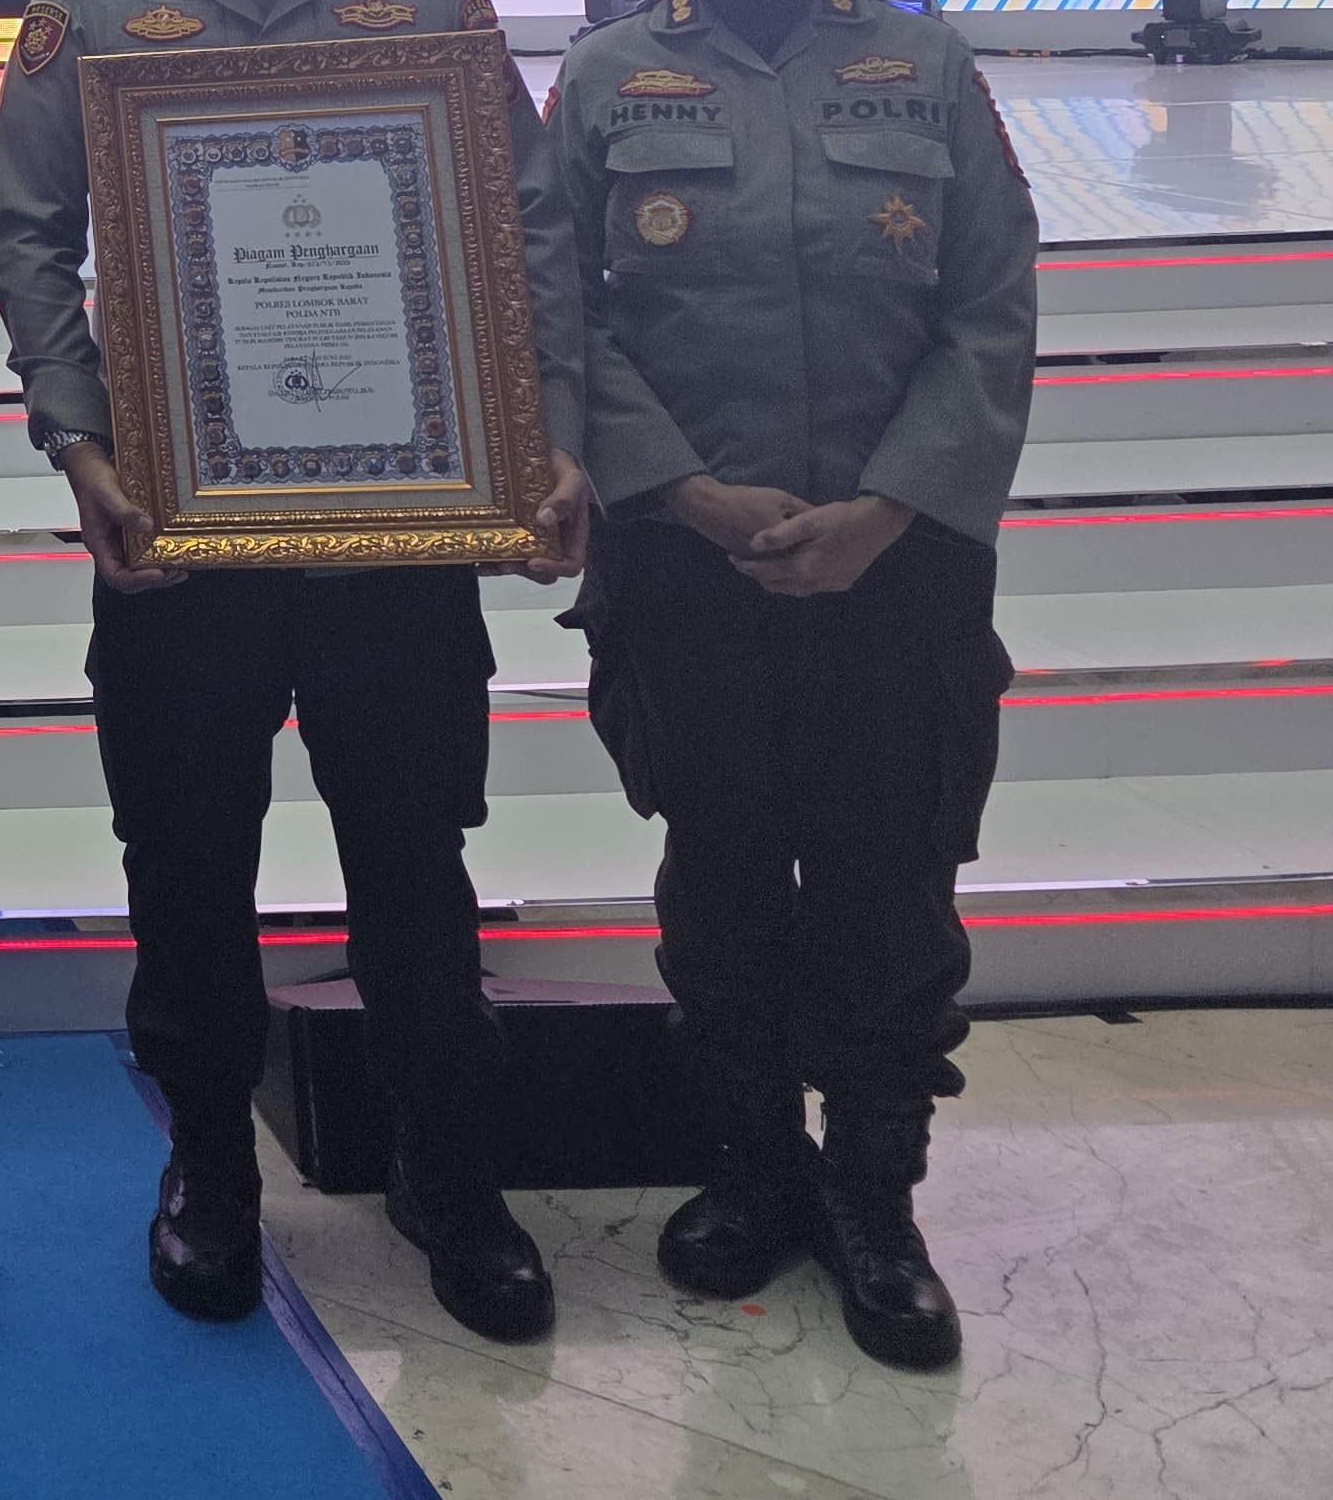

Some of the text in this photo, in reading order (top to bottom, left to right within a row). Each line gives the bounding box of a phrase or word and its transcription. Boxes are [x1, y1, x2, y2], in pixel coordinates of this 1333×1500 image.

[609, 103, 722, 126] HENNY
[822, 98, 941, 124] POLRI
[233, 243, 380, 264] Piagam Penghargaan
[254, 300, 291, 310] POLRES
[292, 298, 334, 308] LOMBOK
[285, 309, 319, 319] POLDA
